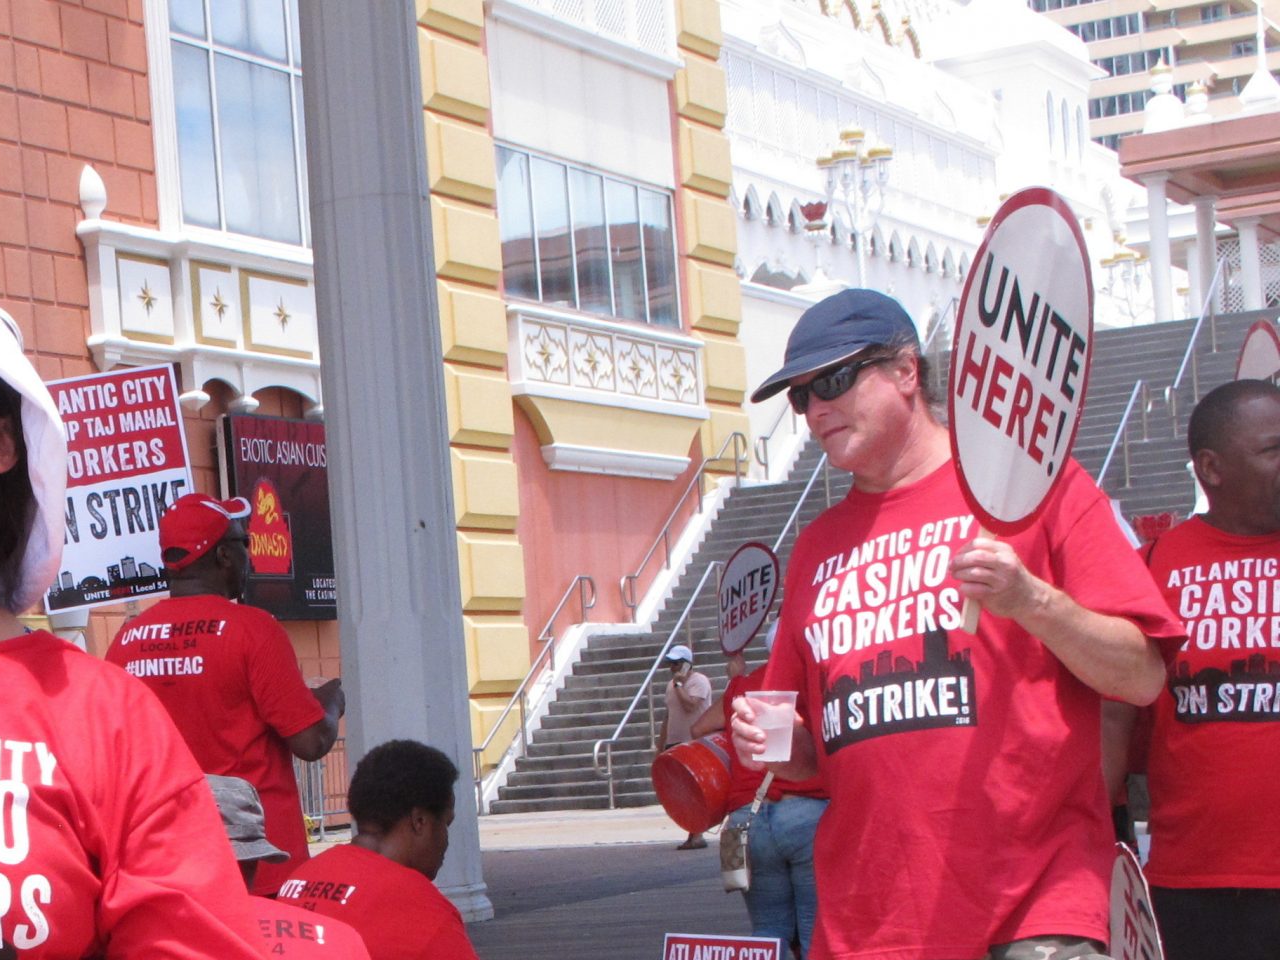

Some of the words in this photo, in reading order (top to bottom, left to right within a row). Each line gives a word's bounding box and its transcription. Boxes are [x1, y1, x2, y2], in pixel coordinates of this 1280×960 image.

[978, 250, 1086, 403] UNITE
[58, 382, 118, 416] ANTIC
[122, 375, 166, 405] CITY
[956, 330, 1067, 477] HERE!
[83, 415, 115, 438] TAJ
[119, 406, 176, 433] MAHAL
[68, 437, 166, 479] ORKERS
[240, 437, 275, 464] EXOTIC
[276, 441, 305, 466] ASIAN
[306, 442, 327, 468] CUIS
[249, 531, 288, 557] DYNASTY
[812, 528, 913, 586] ATLANTIC
[918, 515, 975, 548] CITY
[721, 564, 772, 612] UNITE
[814, 545, 951, 618] CASINO
[1167, 558, 1278, 588] ATLANTIC
[721, 587, 768, 639] HERE!
[804, 587, 962, 664] WORKERS
[125, 656, 204, 677] #UNITEAC
[140, 642, 179, 652] LOCAL
[183, 639, 197, 649] 54
[848, 676, 969, 730] STRIKE!
[1217, 682, 1280, 714] STRI
